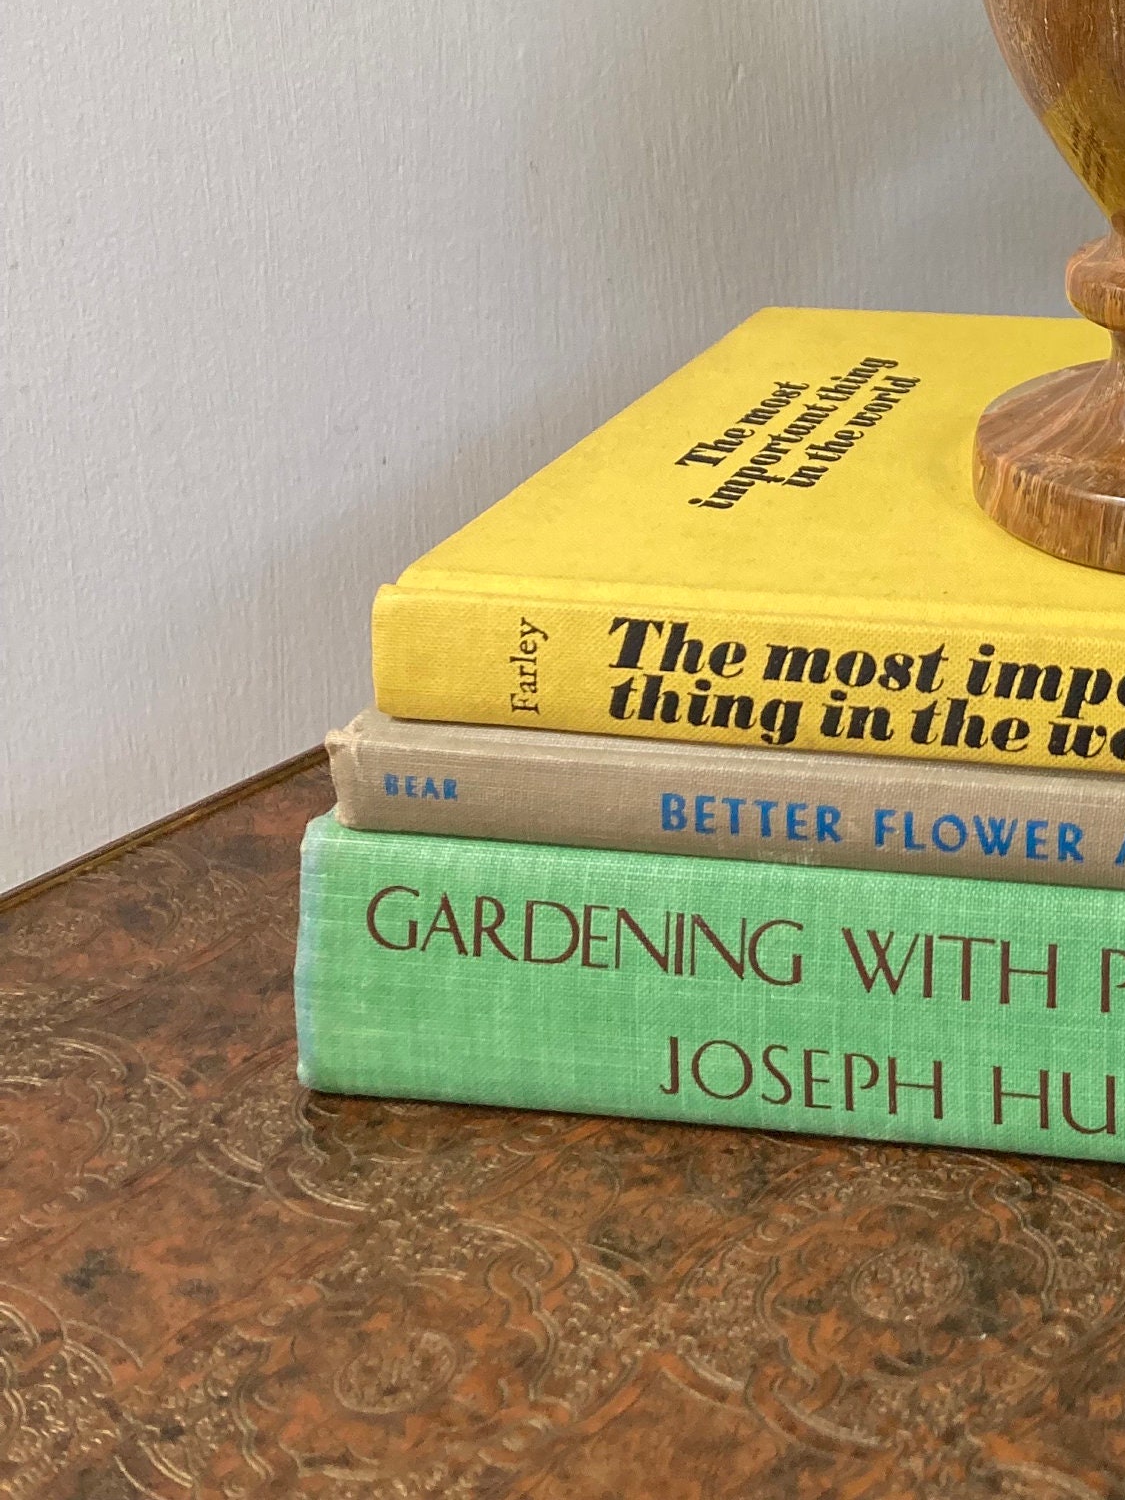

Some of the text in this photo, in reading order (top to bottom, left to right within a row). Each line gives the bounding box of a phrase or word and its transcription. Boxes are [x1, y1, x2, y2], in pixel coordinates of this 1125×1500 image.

[674, 380, 811, 468] The most
[687, 356, 900, 510] important thing
[782, 375, 922, 488] in the world
[510, 616, 550, 715] Farley
[608, 616, 748, 679] The
[763, 641, 950, 694] most
[608, 673, 803, 746] thing
[819, 688, 894, 742] in
[910, 698, 1031, 753] the
[383, 773, 460, 801] BEAR
[660, 792, 843, 844] BETTER
[872, 807, 1085, 863] FLOWER
[365, 885, 804, 987] GARDENING
[840, 926, 1059, 1010] WITH
[659, 1035, 944, 1121] JOSEPH
